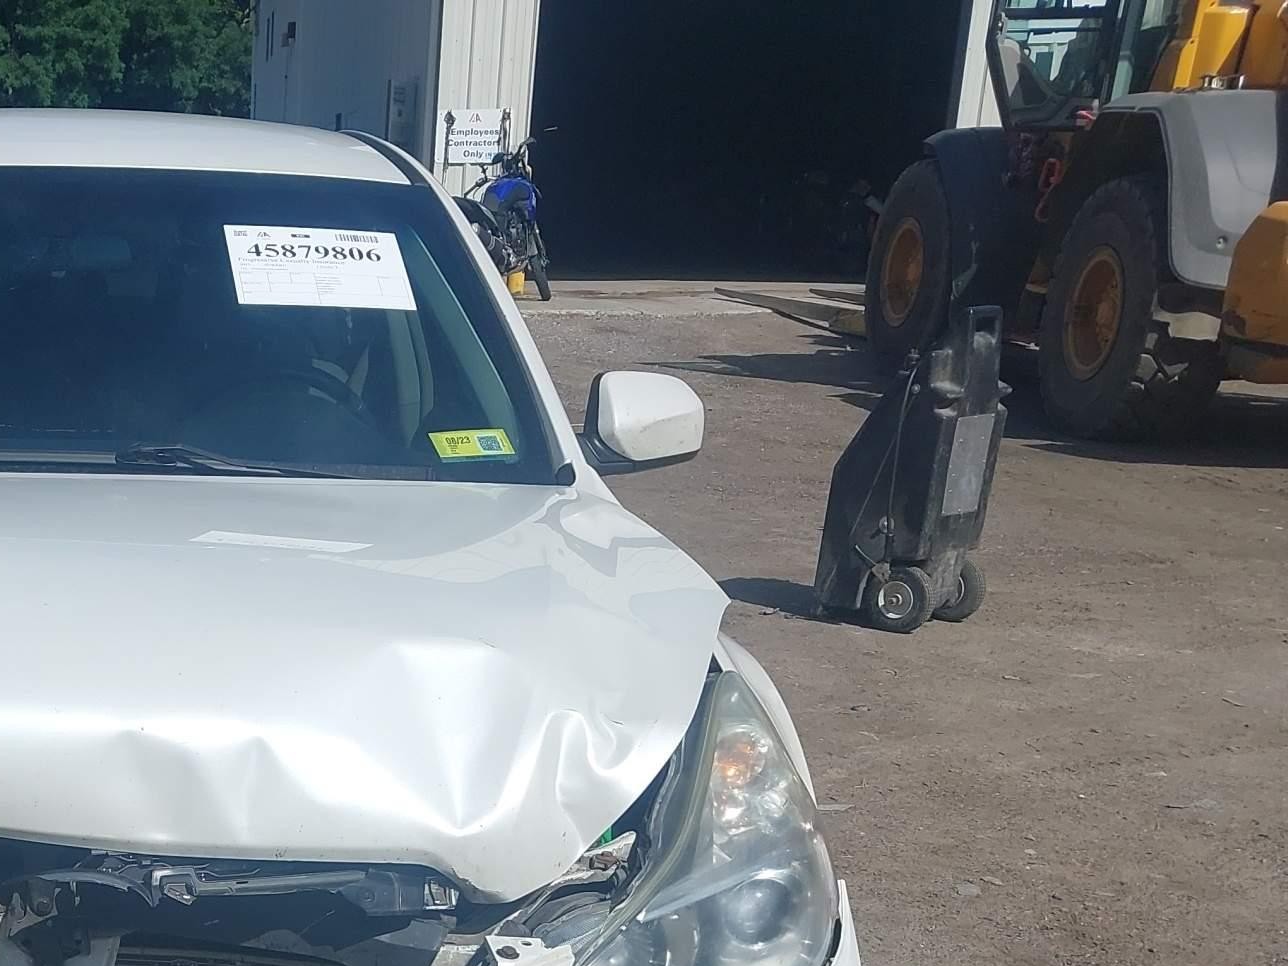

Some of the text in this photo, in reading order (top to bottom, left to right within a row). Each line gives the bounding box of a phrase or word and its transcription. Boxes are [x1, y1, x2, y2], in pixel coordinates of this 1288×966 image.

[450, 128, 499, 137] Employees
[463, 150, 484, 158] Only
[247, 243, 382, 263] 45879806
